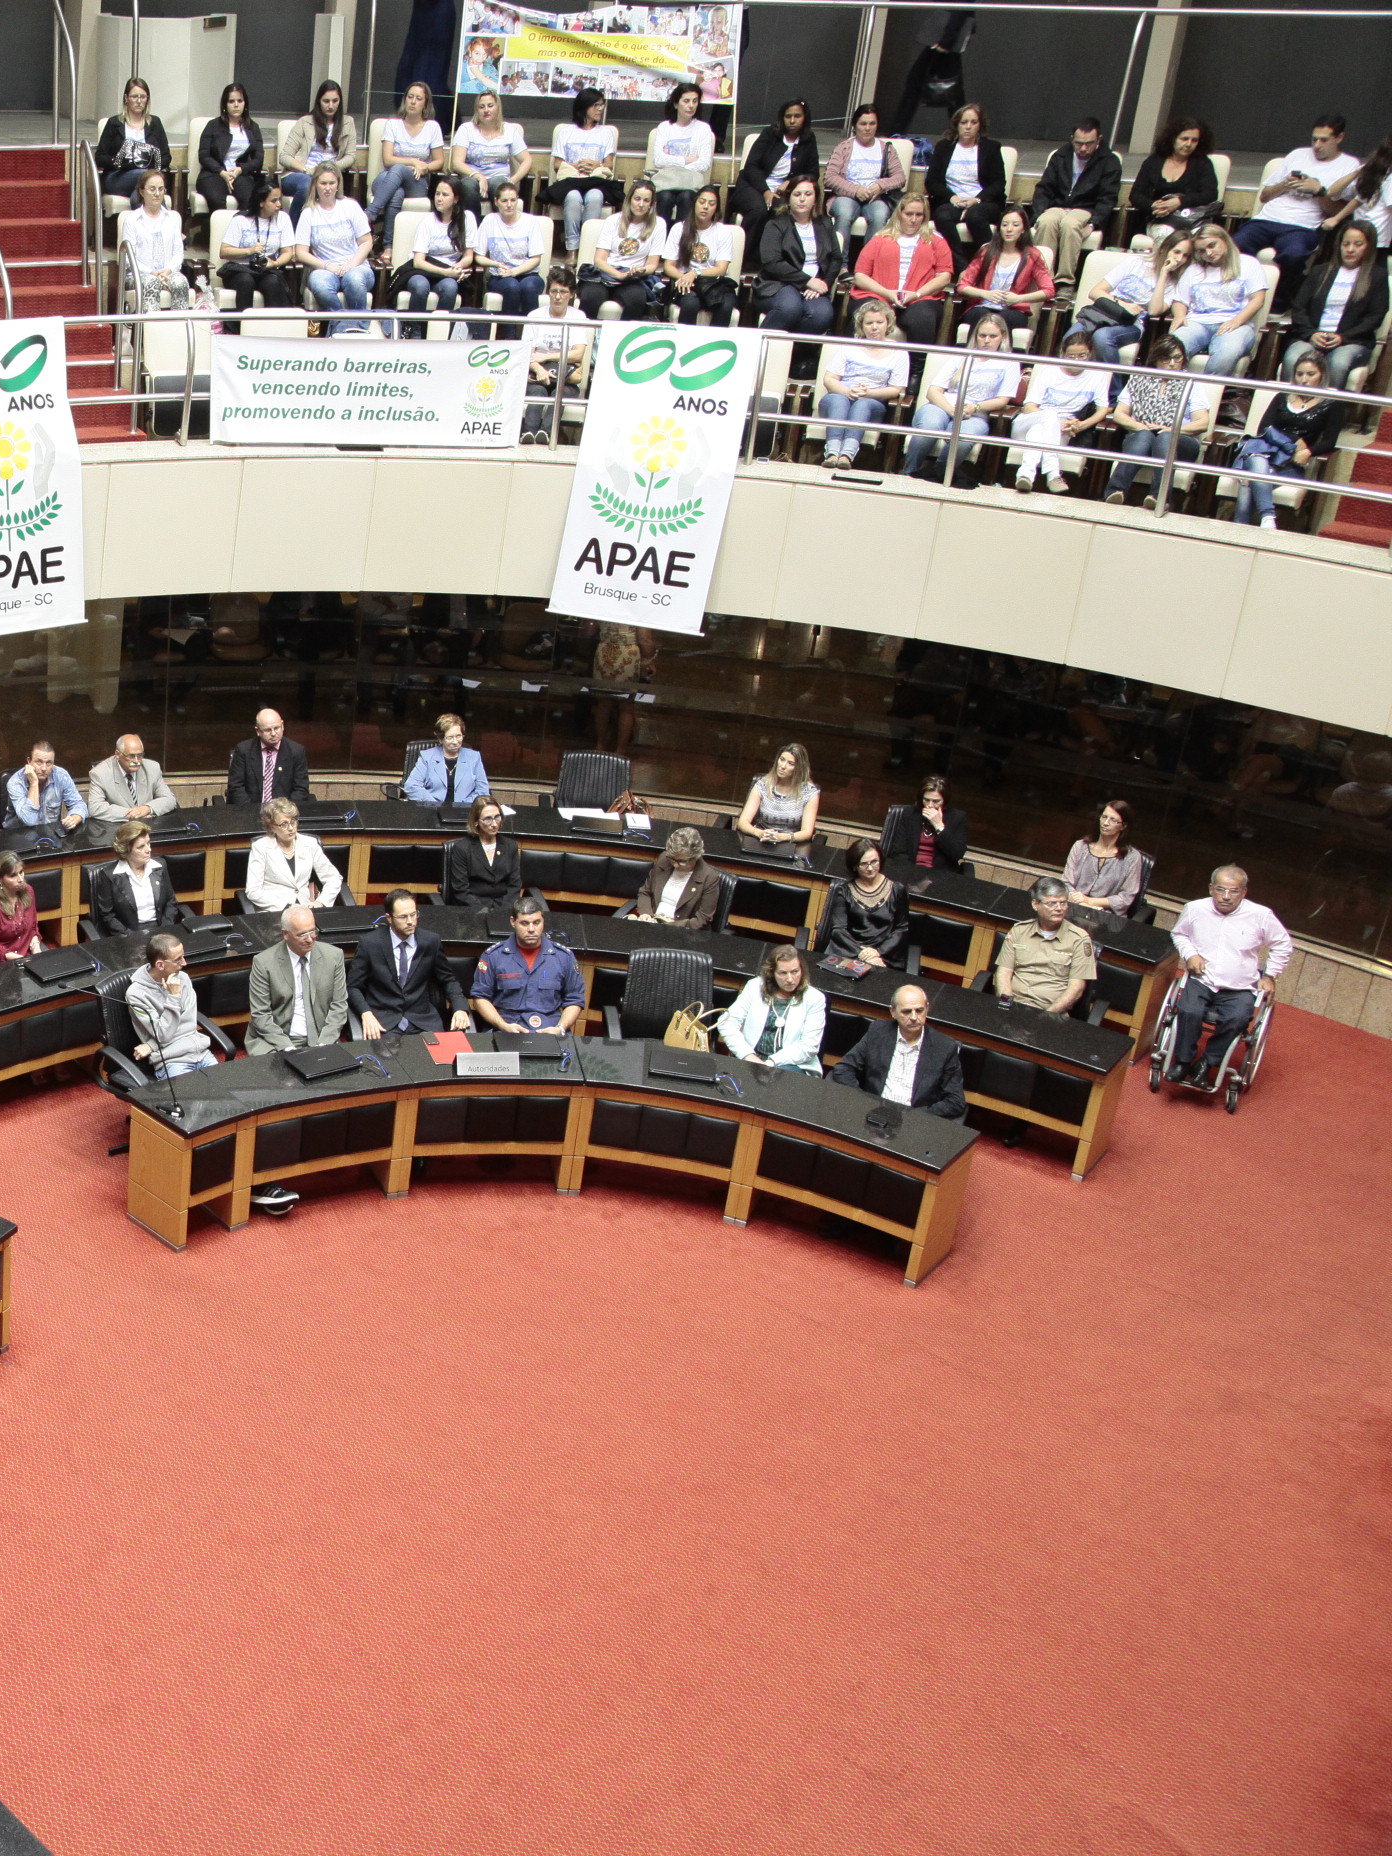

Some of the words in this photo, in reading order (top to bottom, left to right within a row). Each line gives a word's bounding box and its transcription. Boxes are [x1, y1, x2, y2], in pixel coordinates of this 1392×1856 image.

[528, 33, 536, 41] O
[539, 33, 591, 45] importante
[538, 49, 558, 57] mas
[236, 354, 338, 375] Superando
[343, 356, 433, 376] barreiras,
[613, 324, 738, 392] 60
[251, 382, 340, 397] vencendo
[346, 380, 414, 400] limites,
[7, 393, 55, 412] ANOS
[672, 394, 728, 416] ANOS
[222, 404, 336, 422] promovendo
[341, 408, 352, 421] a
[358, 405, 440, 422] inclusão.
[460, 421, 503, 436] APAE
[573, 537, 696, 589] APAE
[34, 591, 54, 606] SC
[583, 582, 638, 604] Brusque
[650, 592, 672, 607] SC
[467, 1065, 510, 1073] Autoridades
